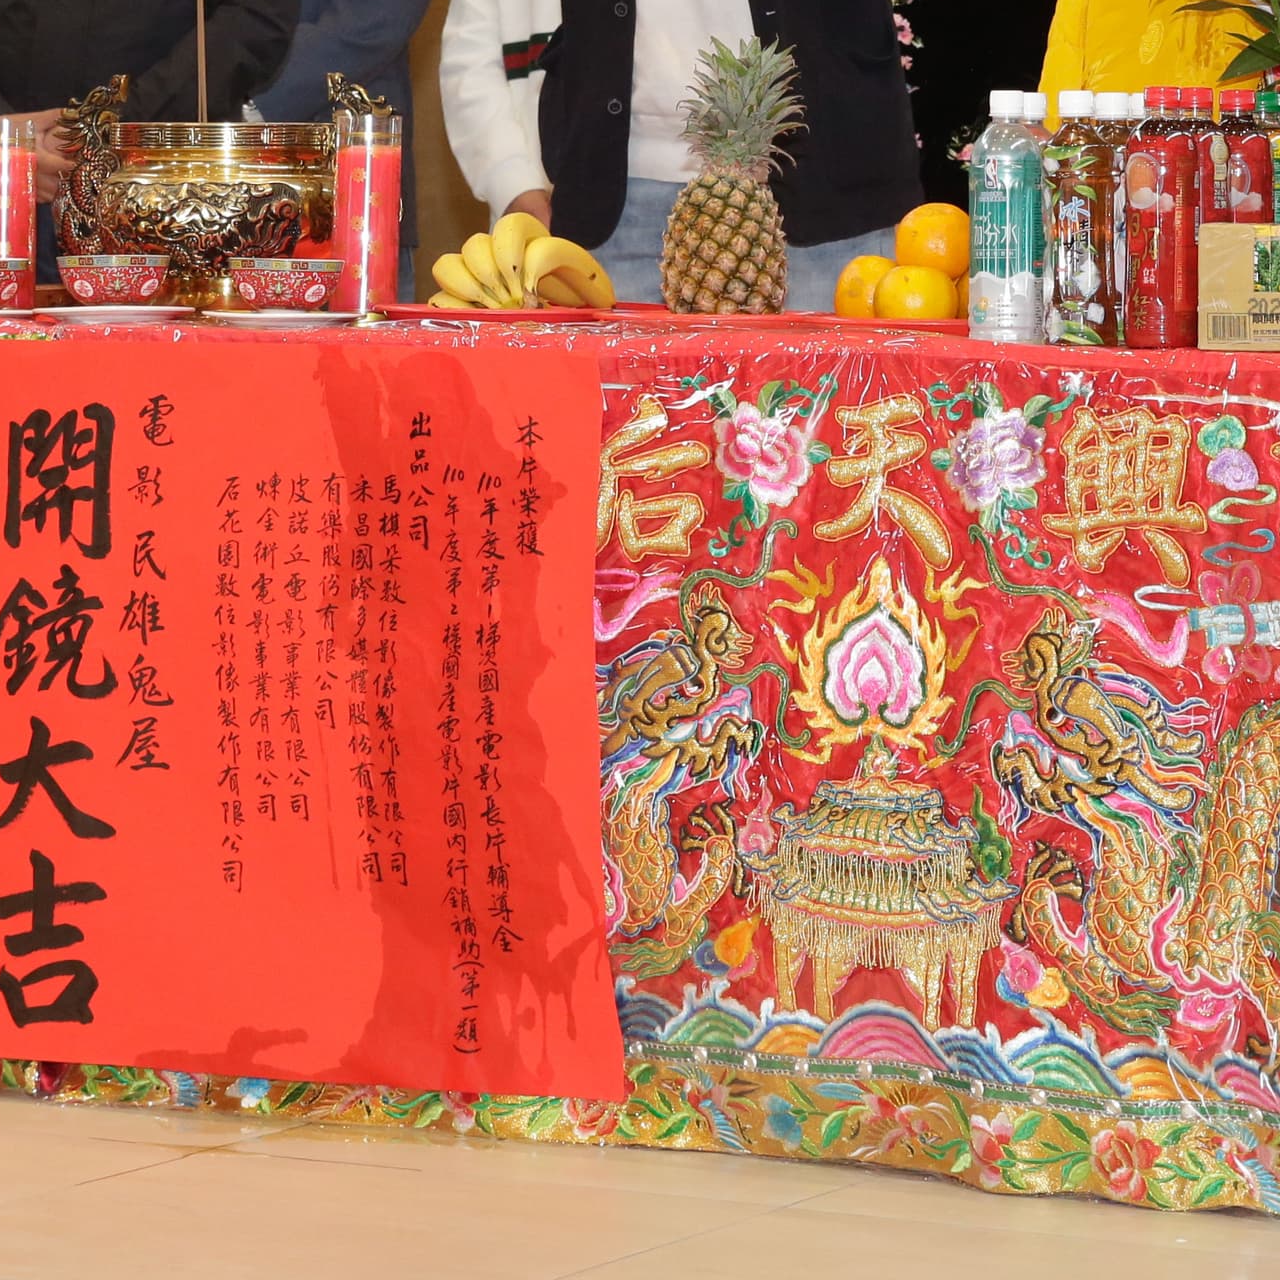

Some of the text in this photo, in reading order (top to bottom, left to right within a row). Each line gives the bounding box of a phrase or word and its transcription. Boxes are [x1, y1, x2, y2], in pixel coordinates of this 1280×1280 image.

[116, 394, 175, 772] 電影民雄鬼屋
[407, 411, 434, 552] 出品公司
